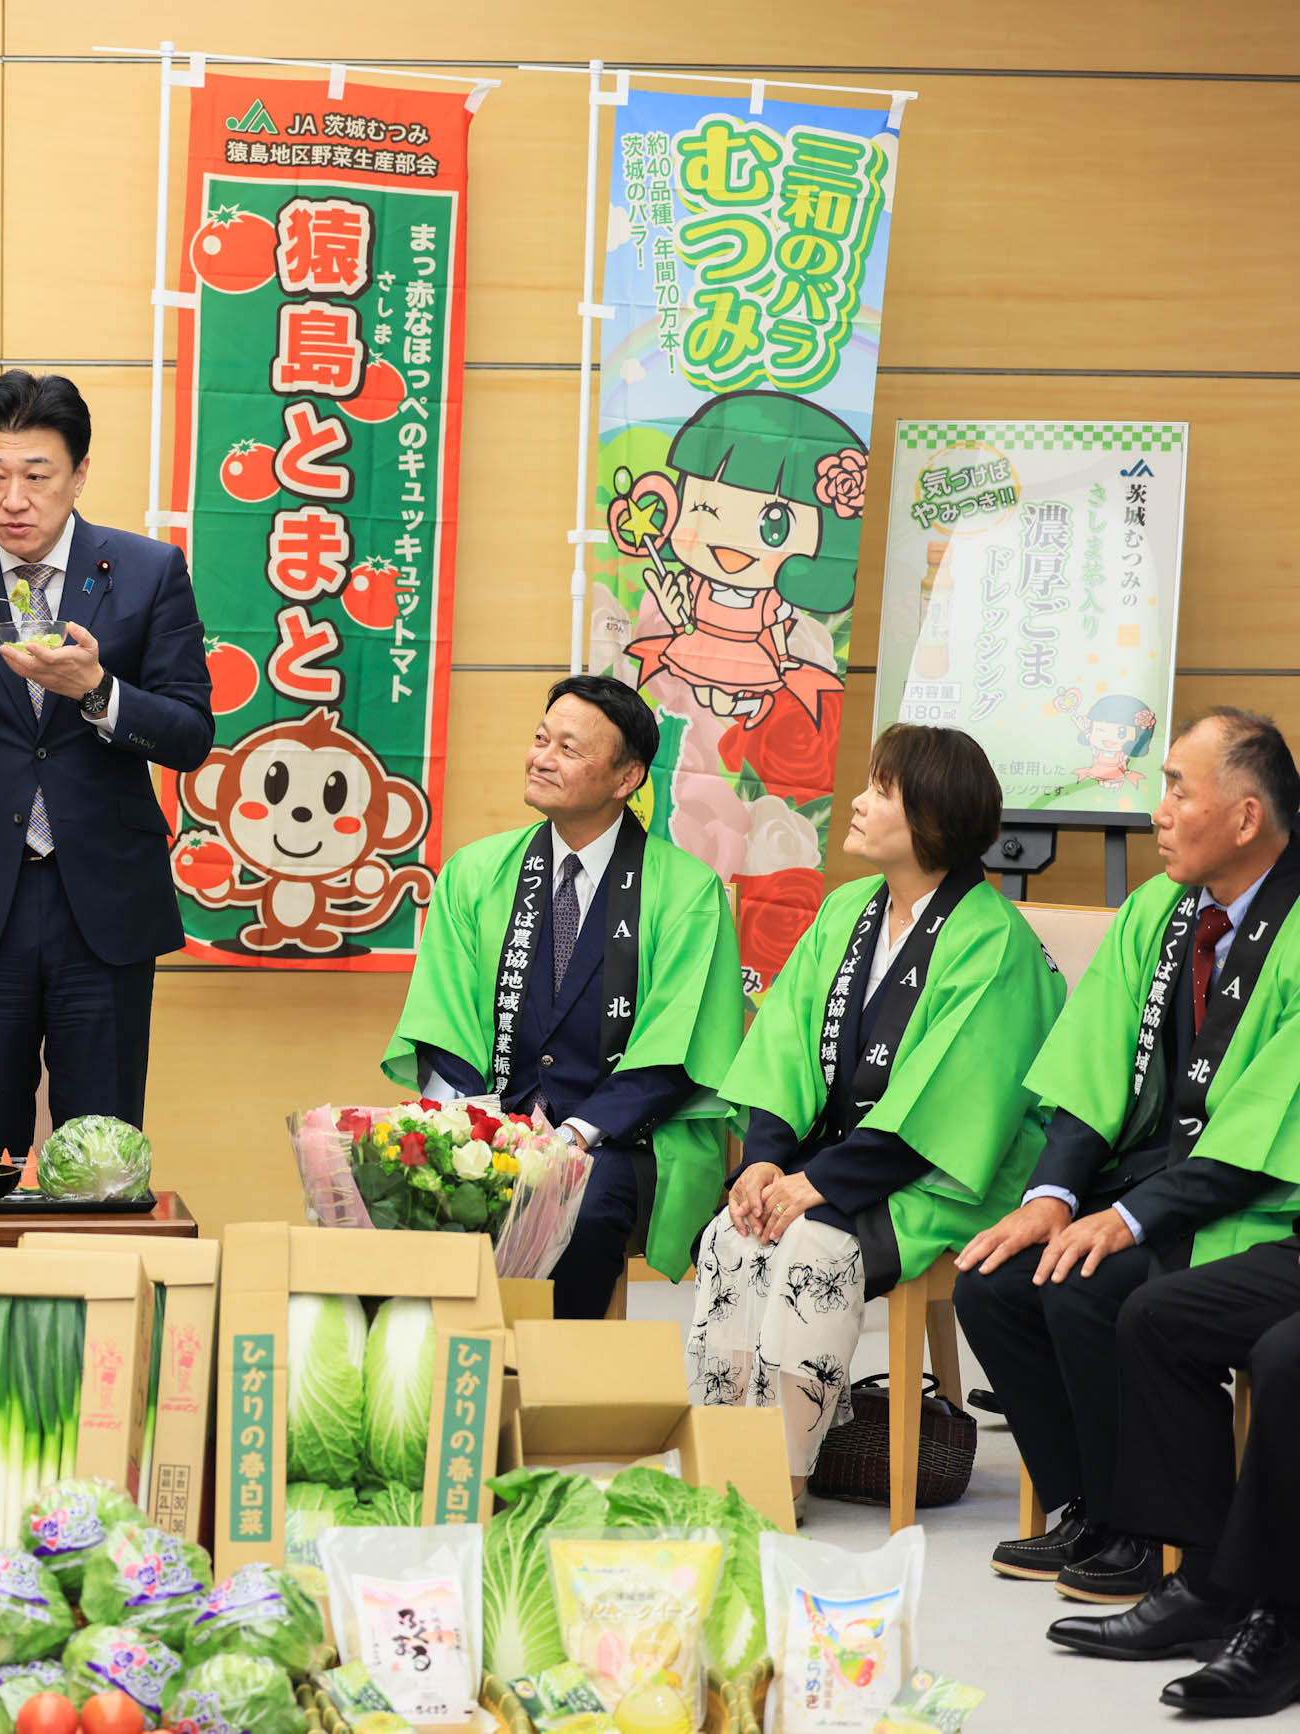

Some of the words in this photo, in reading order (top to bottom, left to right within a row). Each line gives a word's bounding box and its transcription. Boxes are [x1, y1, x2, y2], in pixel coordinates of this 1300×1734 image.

[226, 140, 438, 177] 猿島地区野菜生産部会
[287, 114, 318, 136] JA
[324, 113, 430, 145] 茨城むつみ
[622, 134, 648, 269] 茨城のバラ!
[374, 271, 397, 345] さしま
[646, 134, 681, 375] 約40品種、年間70万本!
[677, 120, 783, 372] むつみ
[766, 130, 868, 368] 三和のバラ
[266, 197, 375, 704] 猿島とまと
[390, 223, 437, 703] まっ赤なほっぺのキュッキュットマト
[922, 458, 1011, 500] 気づけば
[1017, 503, 1071, 688] 濃厚ごま
[1078, 483, 1107, 640] さしま茶入り
[1120, 483, 1147, 608] 茨城むつみの
[971, 546, 1013, 722] ドレッシング
[992, 760, 1068, 776] を使用した
[239, 1340, 267, 1536] ひかりの春白菜
